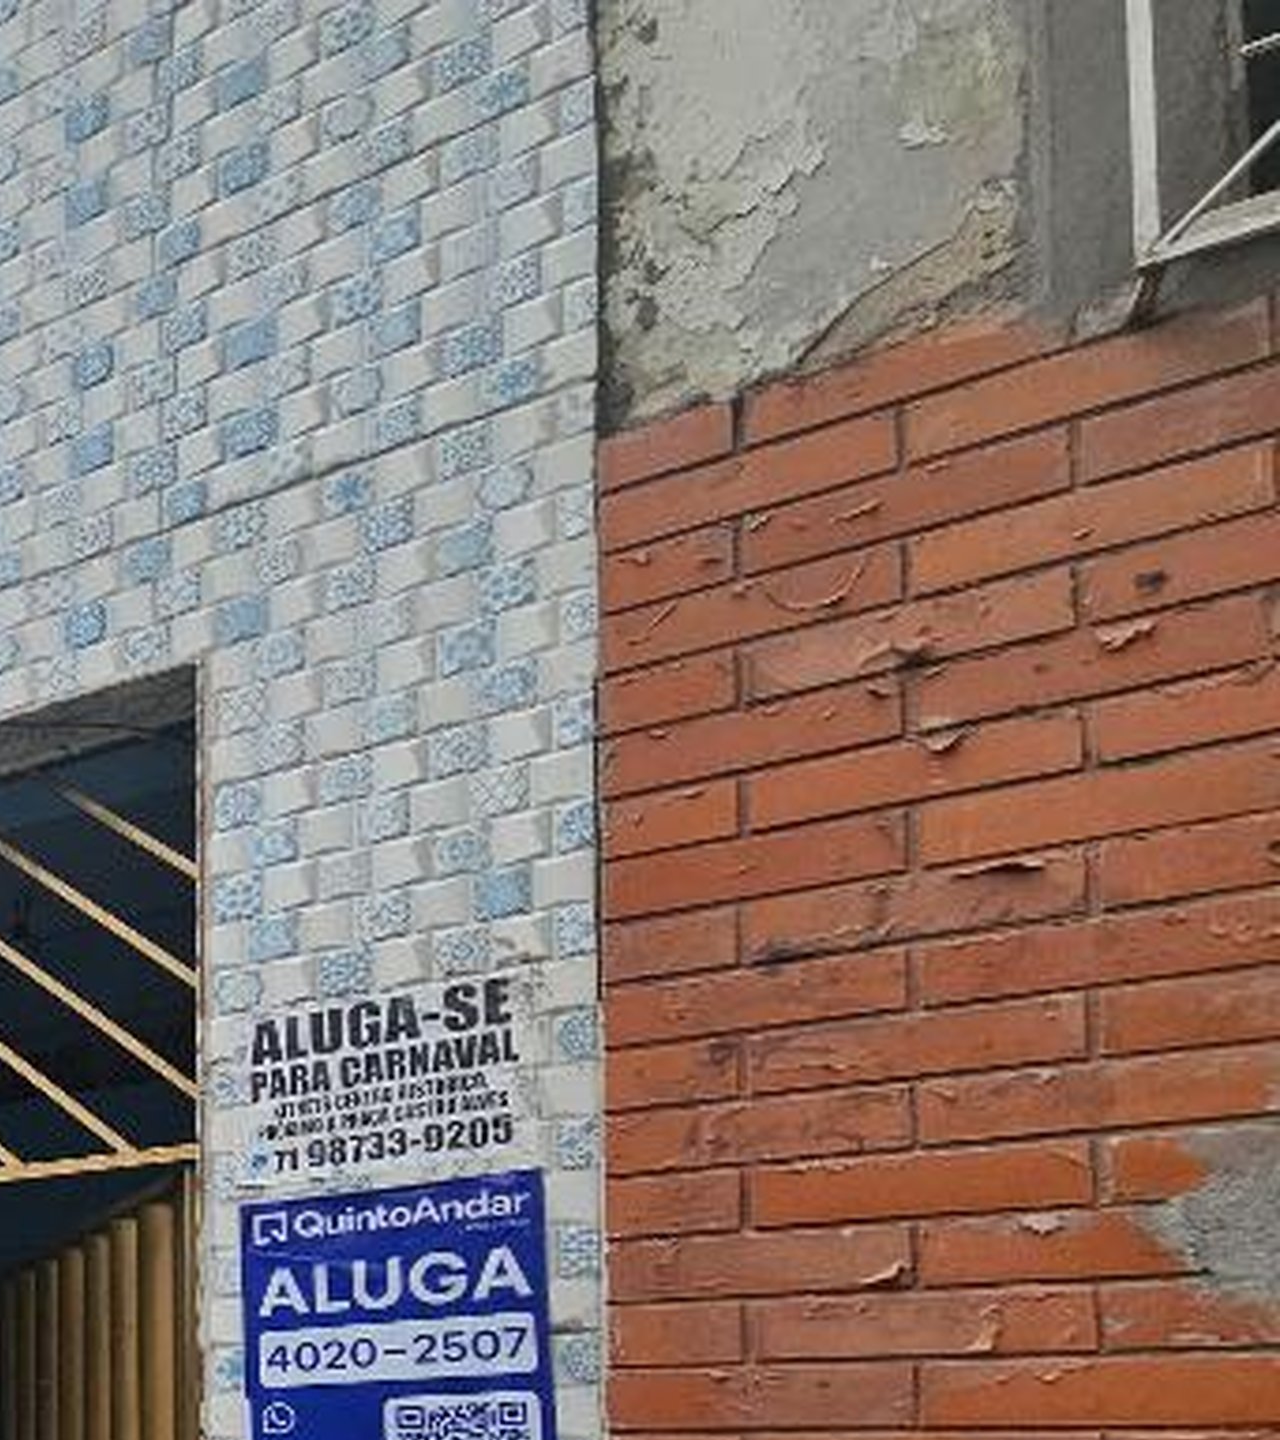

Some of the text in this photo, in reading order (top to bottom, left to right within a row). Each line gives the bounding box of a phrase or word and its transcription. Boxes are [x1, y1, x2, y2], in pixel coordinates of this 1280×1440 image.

[251, 978, 512, 1066] ALUGA-SE
[251, 1029, 519, 1104] PARA CARNAVAL
[274, 1147, 299, 1175] 71
[308, 1113, 514, 1168] 98733-9205
[293, 1190, 531, 1240] QuintoAndar
[258, 1245, 534, 1318] ALUGA
[266, 1326, 529, 1372] 4020-2507
